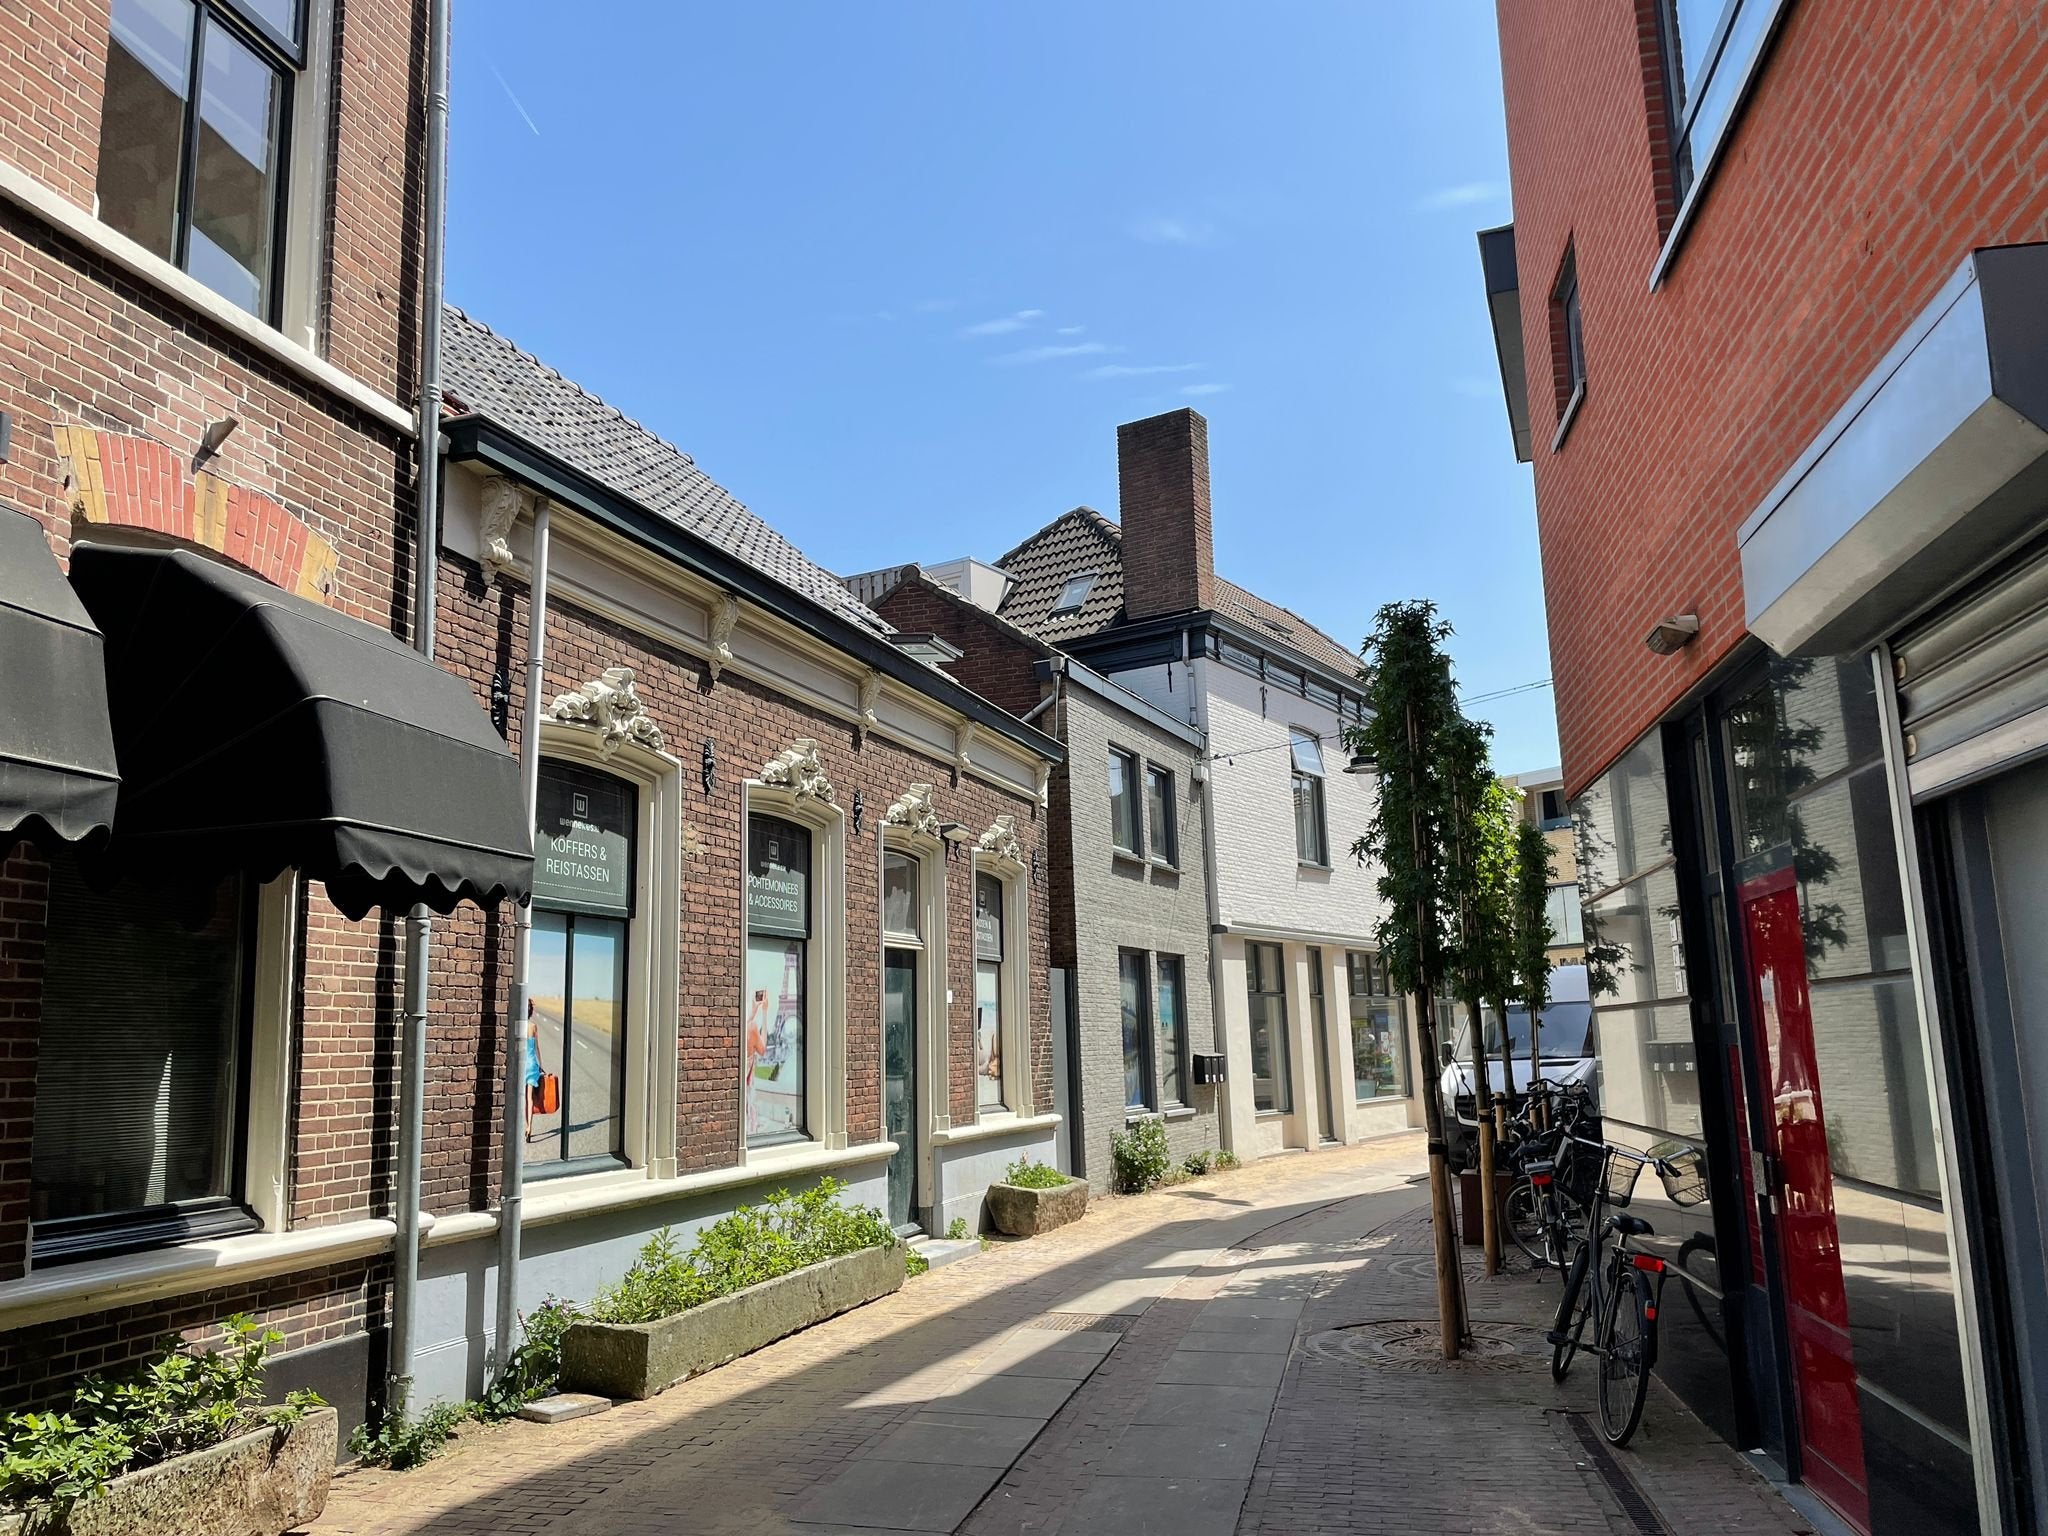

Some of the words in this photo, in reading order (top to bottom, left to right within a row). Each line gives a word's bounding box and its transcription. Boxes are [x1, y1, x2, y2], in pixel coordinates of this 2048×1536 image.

[551, 837, 598, 859] KOFFERS
[599, 846, 607, 861] &
[546, 858, 610, 882] REISTASSEN
[748, 874, 799, 896] PORTEMONNEES
[749, 893, 754, 906] &
[755, 894, 798, 913] ACCESSOIRES
